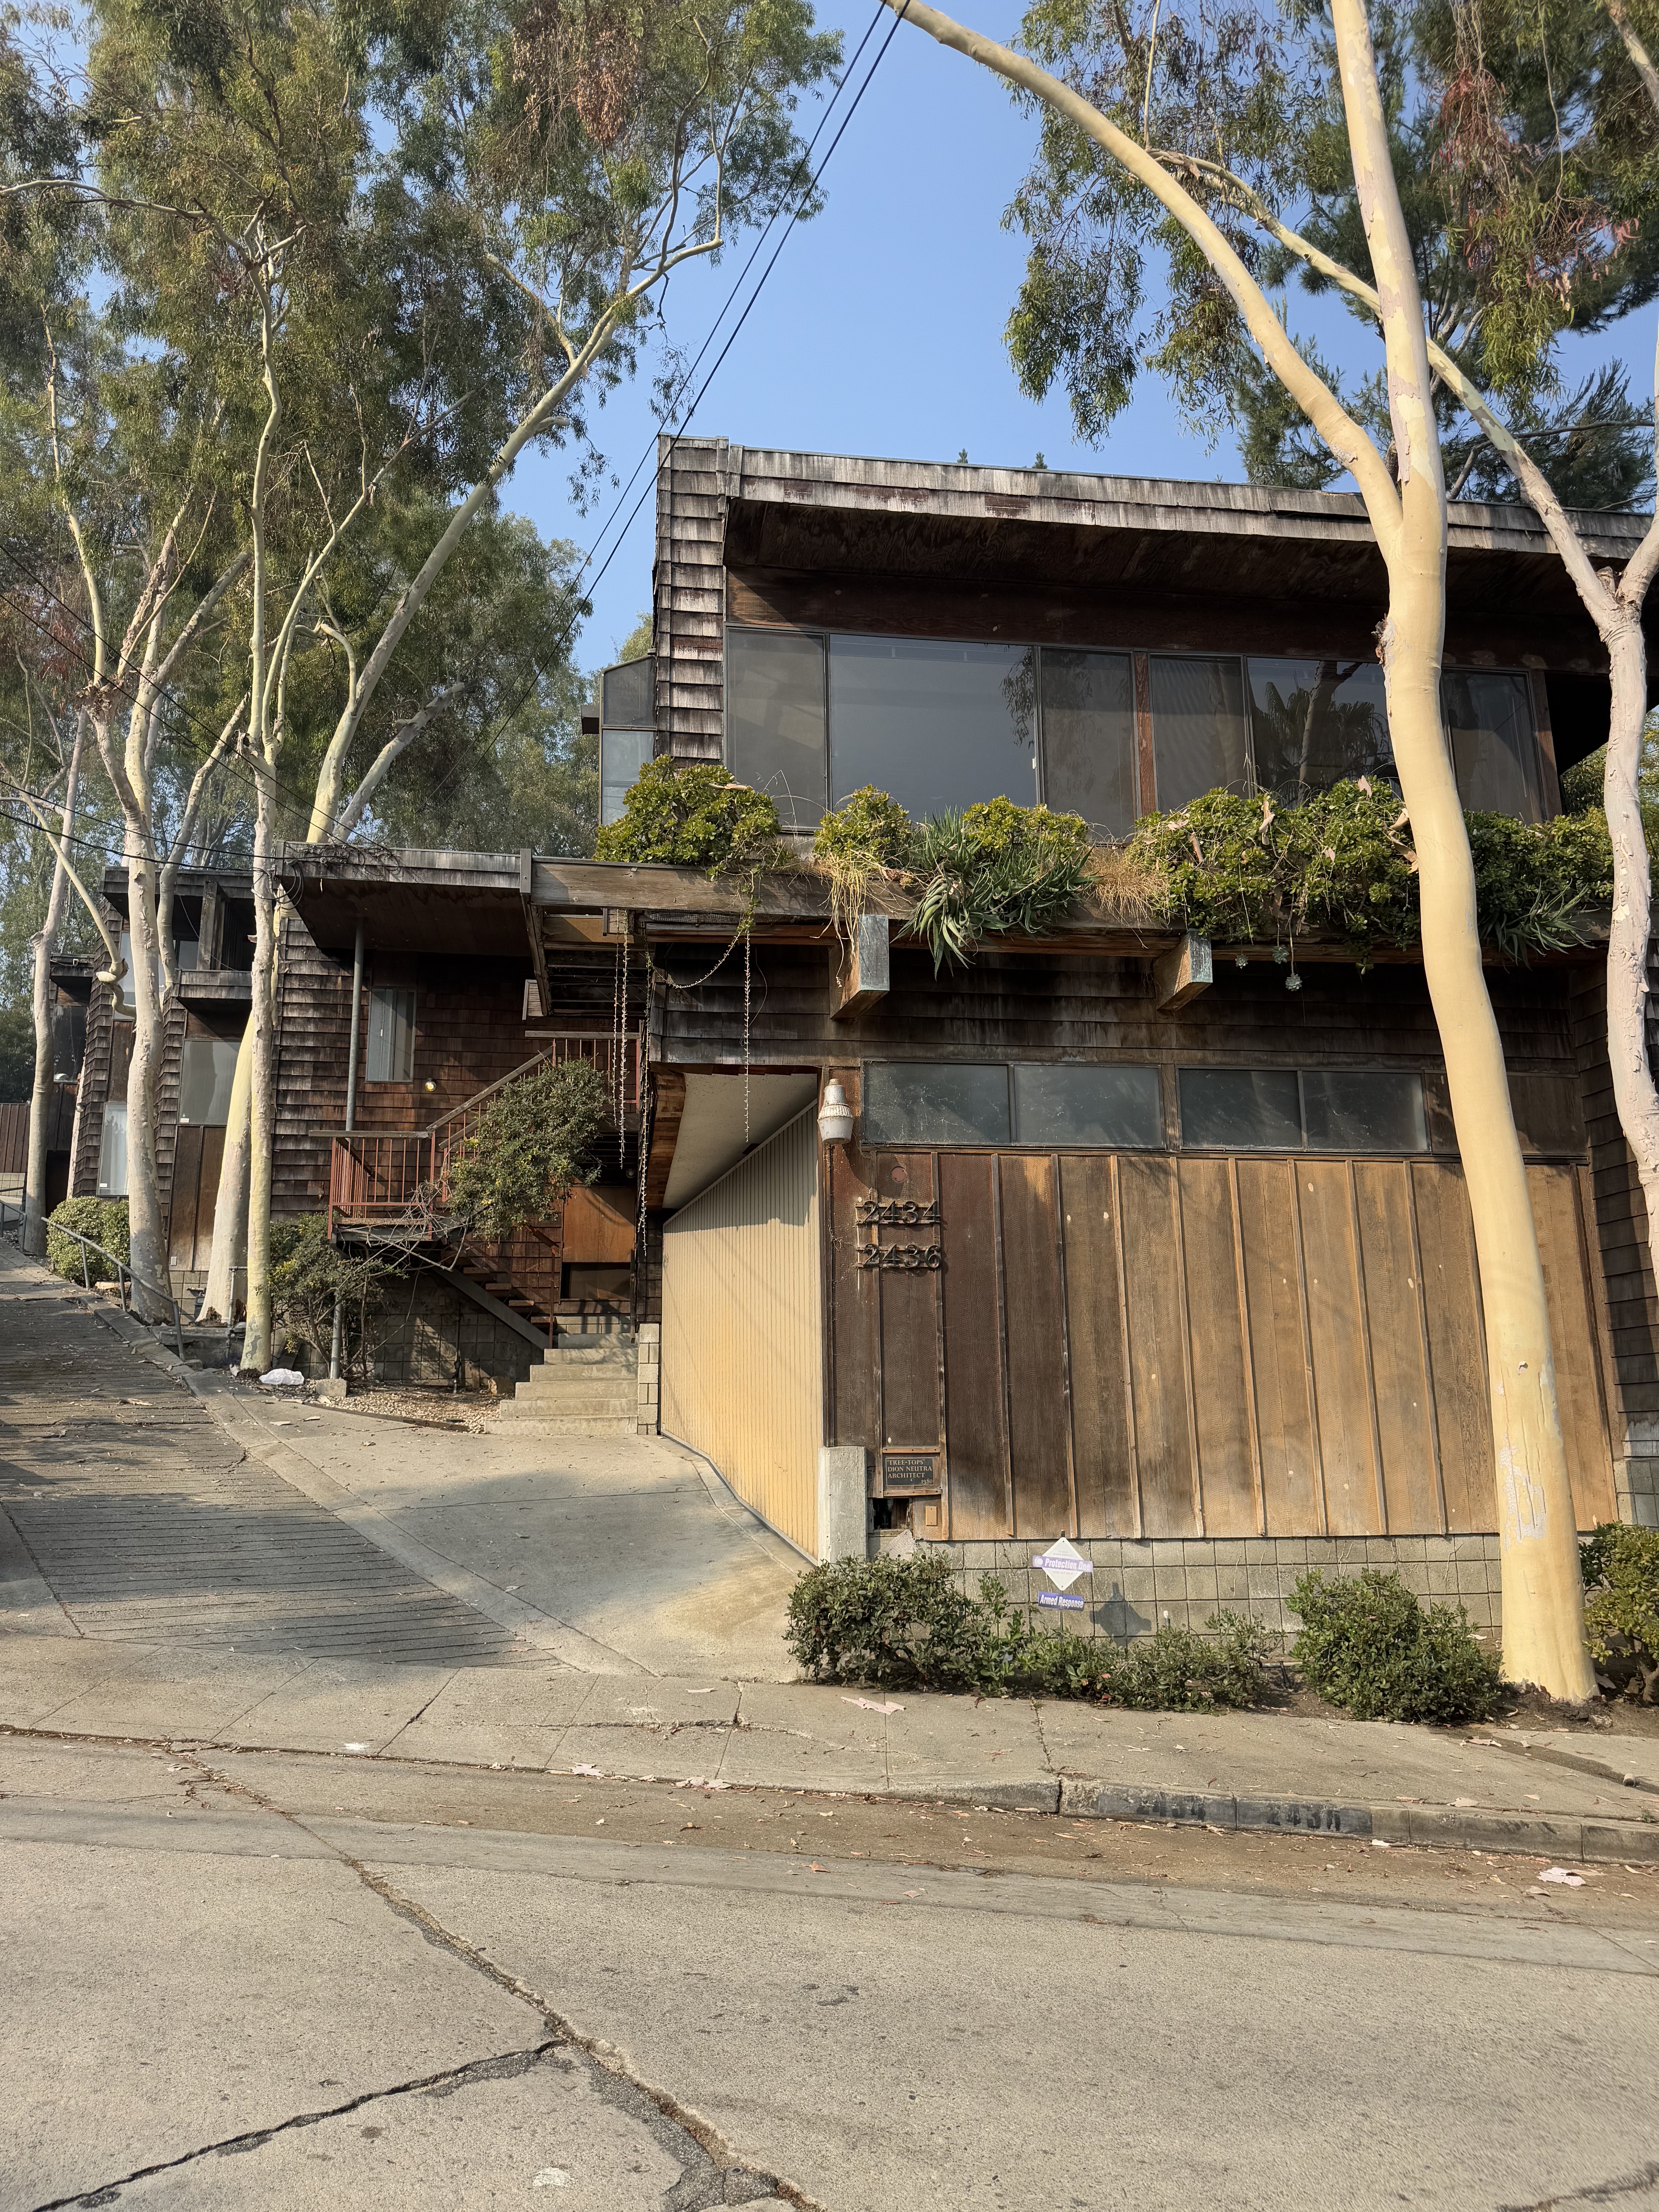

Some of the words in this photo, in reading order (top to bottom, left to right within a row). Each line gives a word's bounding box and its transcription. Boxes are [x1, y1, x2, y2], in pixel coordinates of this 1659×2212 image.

[863, 1200, 940, 1224] 2434
[863, 1243, 941, 1269] 2436
[1045, 1558, 1077, 1570] Protection
[1078, 1561, 1091, 1571] One
[1039, 1594, 1058, 1606] Armed
[1058, 1596, 1084, 1609] Response
